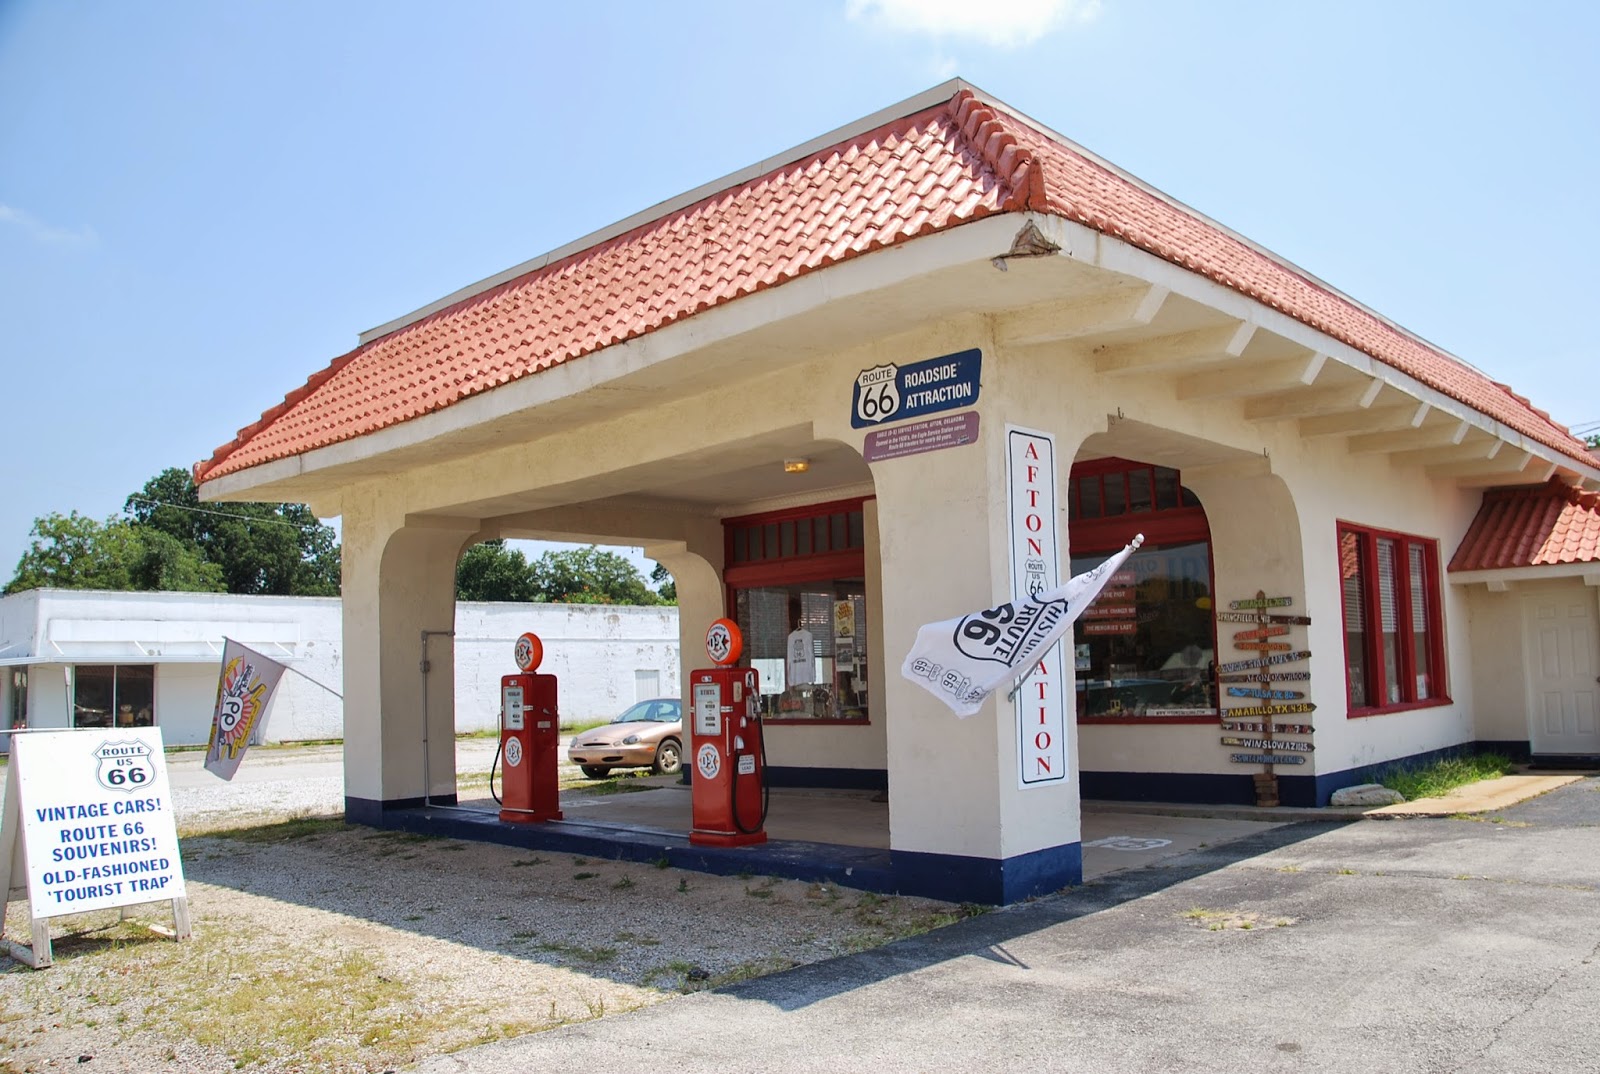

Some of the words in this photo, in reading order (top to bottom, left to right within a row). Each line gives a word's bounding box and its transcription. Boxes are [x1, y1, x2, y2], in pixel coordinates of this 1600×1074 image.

[862, 368, 892, 384] ROUTE
[904, 363, 957, 389] ROADSIDE
[863, 383, 894, 418] 66
[905, 382, 972, 409] ATTRACTION
[1025, 442, 1042, 556] AFTON
[1030, 580, 1044, 595] 66
[964, 602, 1014, 646] 66
[993, 604, 1038, 659] ROUTE
[1016, 606, 1062, 664] HISTO
[915, 660, 928, 672] 66
[943, 673, 957, 688] 66
[1034, 660, 1051, 775] ATION
[102, 746, 145, 756] ROUTE
[117, 758, 133, 766] US
[108, 766, 146, 785] 66
[36, 803, 109, 822] VINTAGE
[114, 798, 162, 814] CARS!
[60, 824, 118, 843] ROUTE
[124, 822, 144, 836] 66
[52, 838, 157, 862] SOUVENIRS!
[43, 858, 170, 885] OLD-FASHIONED
[48, 882, 123, 903] 'TOURIST
[129, 875, 174, 892] TRAP'
